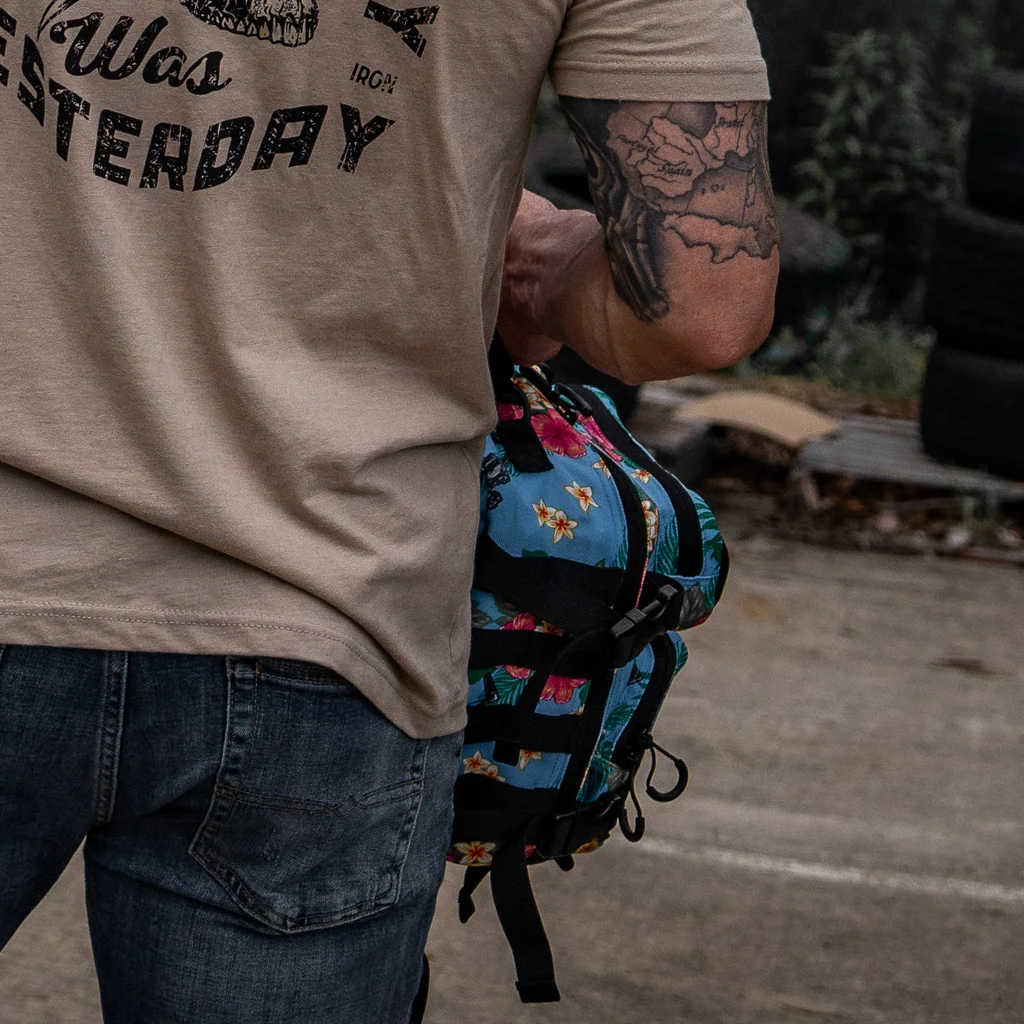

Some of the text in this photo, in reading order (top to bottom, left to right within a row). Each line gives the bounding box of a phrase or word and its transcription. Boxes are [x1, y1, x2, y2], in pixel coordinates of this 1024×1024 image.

[50, 11, 233, 96] Was
[350, 62, 399, 95] IRON
[657, 163, 694, 177] Spain
